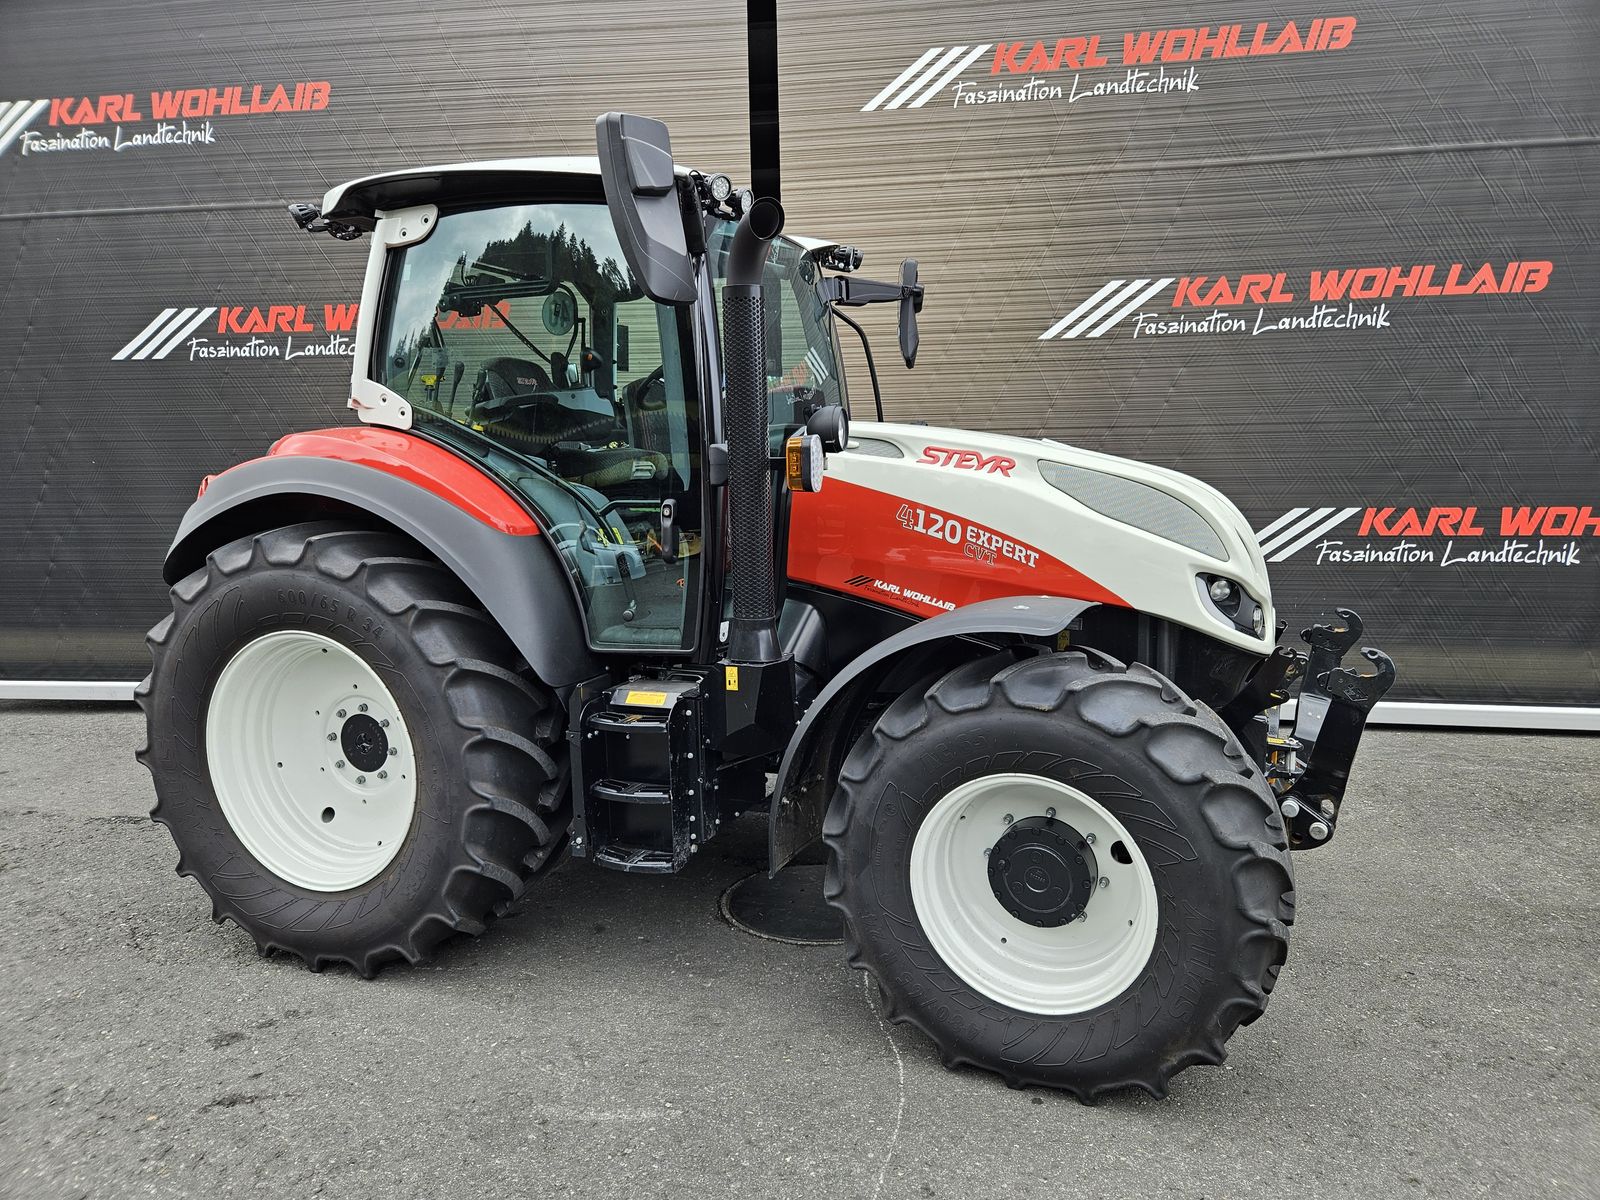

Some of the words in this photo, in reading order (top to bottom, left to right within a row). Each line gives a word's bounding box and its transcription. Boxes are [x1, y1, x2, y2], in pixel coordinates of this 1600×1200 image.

[992, 36, 1107, 75] KARL
[1124, 16, 1356, 65] WOHLLAIB
[49, 95, 141, 126] KARL
[151, 81, 331, 119] WOHLLAIB
[952, 78, 1063, 108] Faszination
[1068, 65, 1201, 104] Landtechnik
[20, 127, 110, 156] Faszination
[114, 120, 215, 151] Landtechnik
[1172, 272, 1293, 307] KARL
[1310, 261, 1553, 301] WOHLLAIB
[218, 305, 314, 333] KARL
[1132, 311, 1246, 339] Faszination
[1252, 302, 1391, 336] Landtechnik
[187, 337, 279, 361] Faszination
[285, 334, 356, 359] Landtec
[916, 446, 1016, 478] STEYR
[895, 503, 962, 545] 4120
[965, 525, 1040, 568] EXPERT
[1357, 506, 1484, 537] KARL
[1499, 506, 1600, 537] WOH
[963, 543, 997, 566] CVT
[1315, 540, 1434, 566] Faszination
[1440, 539, 1580, 567] Landtechnik
[873, 579, 901, 595] KARL
[903, 588, 957, 612] WOHLLAIB
